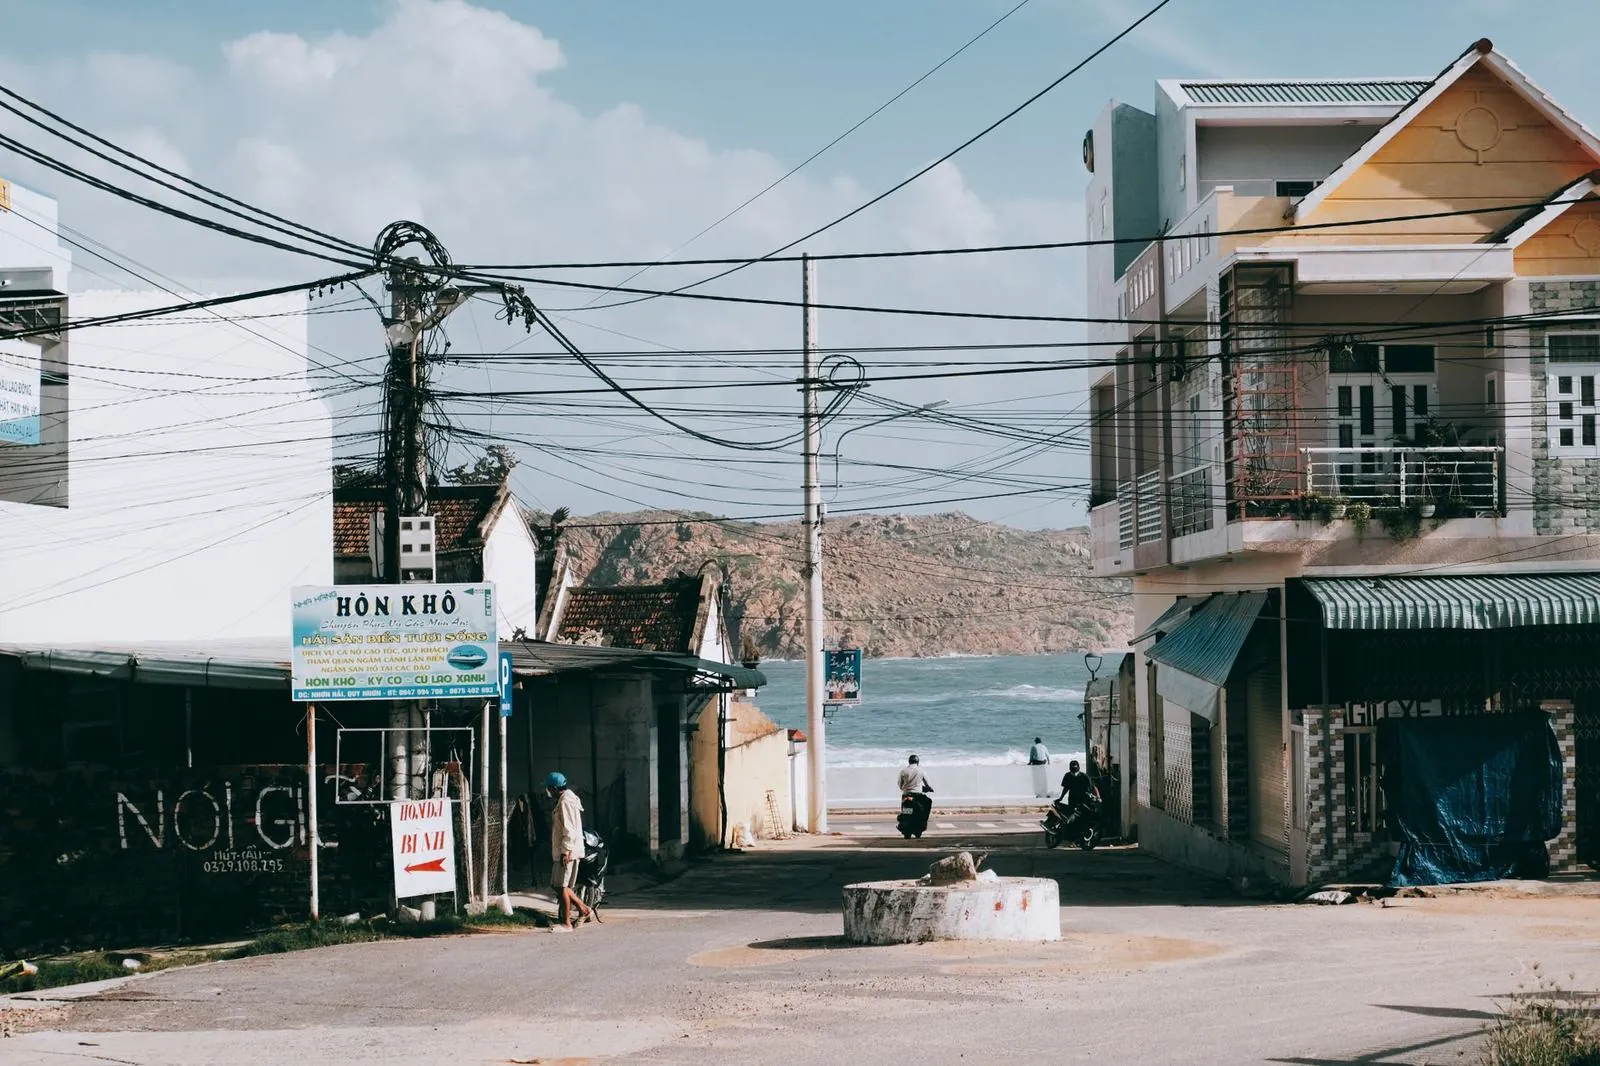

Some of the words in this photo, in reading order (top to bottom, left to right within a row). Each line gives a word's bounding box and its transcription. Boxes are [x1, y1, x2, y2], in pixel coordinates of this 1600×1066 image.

[336, 591, 389, 617] HÒN
[401, 589, 456, 616] KHÔ
[331, 631, 364, 644] SẢN
[366, 631, 401, 644] BIỂN
[445, 628, 488, 642] SỐNG
[305, 675, 330, 687] HÒN
[332, 675, 357, 686] KHÔ
[456, 673, 487, 683] XANH
[501, 657, 510, 700] P
[399, 800, 443, 821] HONDA
[203, 859, 284, 873] 0329.108.295
